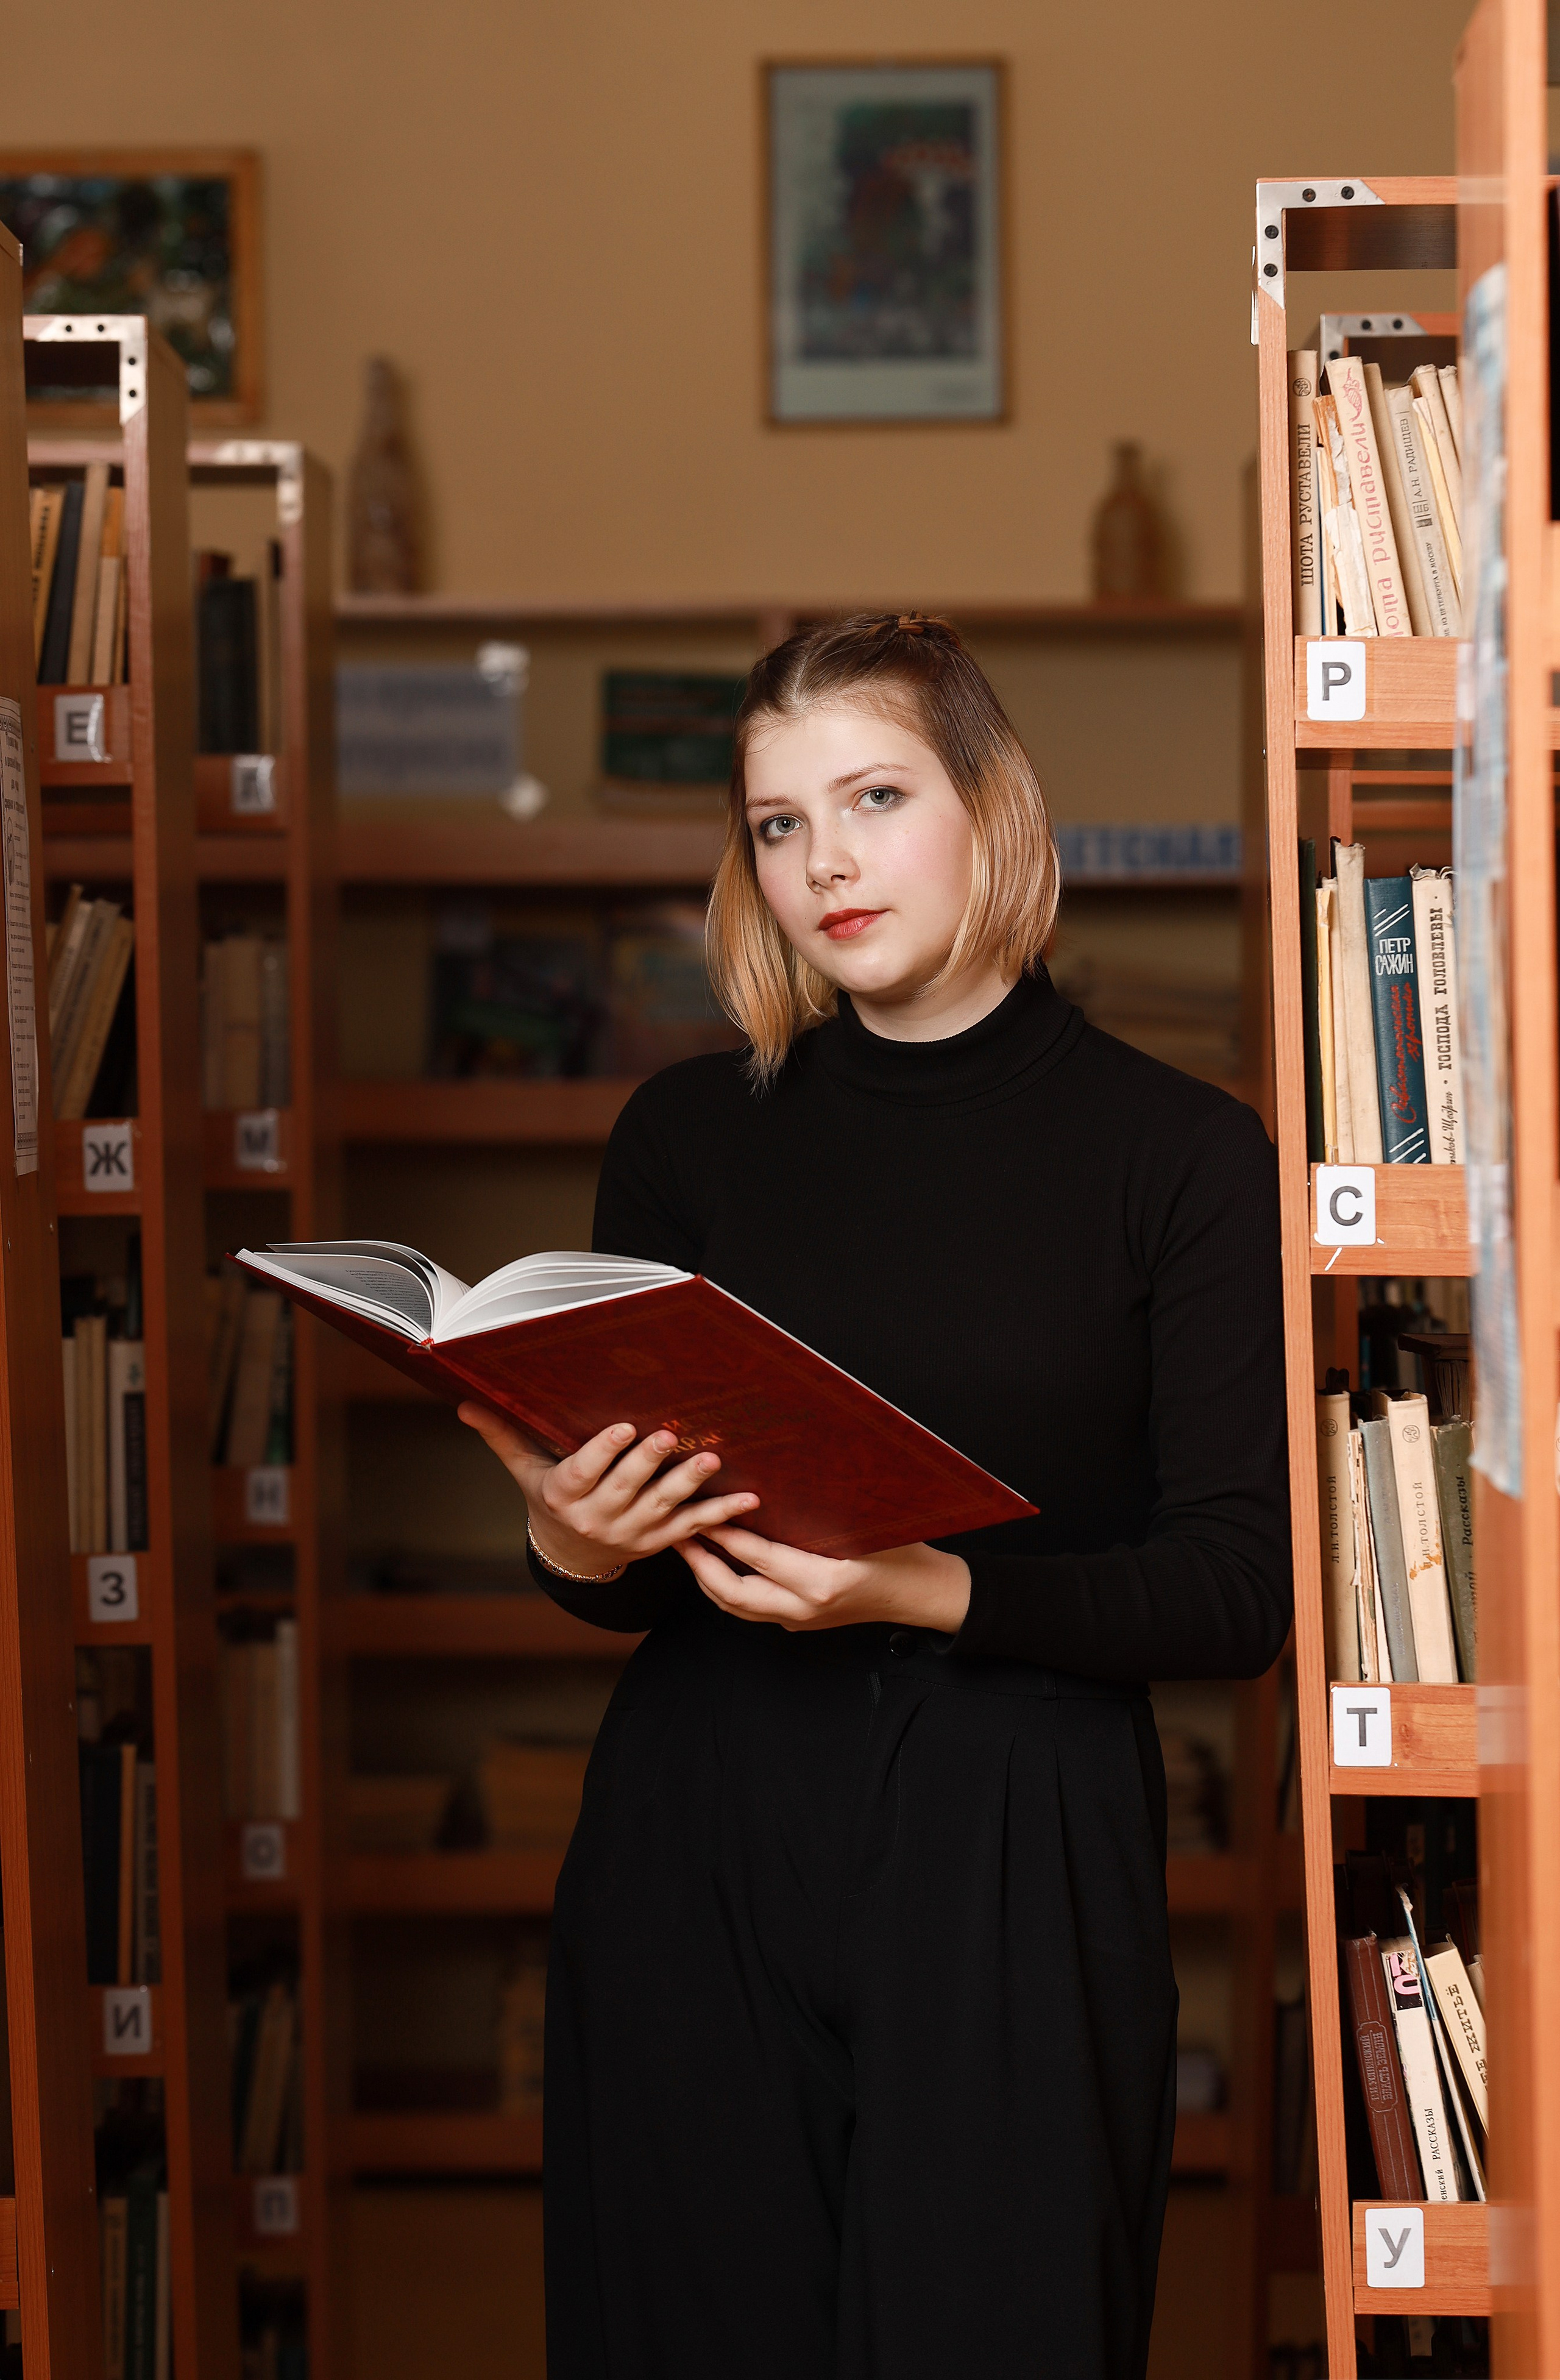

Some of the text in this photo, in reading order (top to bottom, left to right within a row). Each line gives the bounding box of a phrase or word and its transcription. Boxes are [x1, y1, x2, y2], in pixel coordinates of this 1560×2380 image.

[1400, 417, 1417, 473] РАДИЩЕВ
[1298, 423, 1315, 586] ШОТА РУСТАВЕЛИ
[1425, 542, 1437, 568] МОСКВУ
[1433, 575, 1447, 617] ПЕТЕРБУРГА
[1321, 662, 1351, 701] Р
[66, 711, 90, 745] Е
[1375, 954, 1414, 975] САЖИН
[1378, 937, 1411, 955] ПЕТР
[1429, 906, 1448, 995] ГОЛОВЛЕВЫ
[1433, 1003, 1453, 1071] ГОСПОДА
[87, 1141, 127, 1176] Ж
[1329, 1185, 1363, 1226] С
[1454, 1476, 1473, 1546] Рассказы
[101, 1572, 126, 1606] З
[1347, 1708, 1378, 1747] Т
[113, 2005, 141, 2039] И
[1445, 1983, 1481, 2054] ЖИТЬЁ
[1372, 2031, 1394, 2101] ВЛАСТЬ ЗЕМЛИ
[1425, 2107, 1448, 2201] енский РАССКАЗЫ
[1377, 2228, 1411, 2268] У
